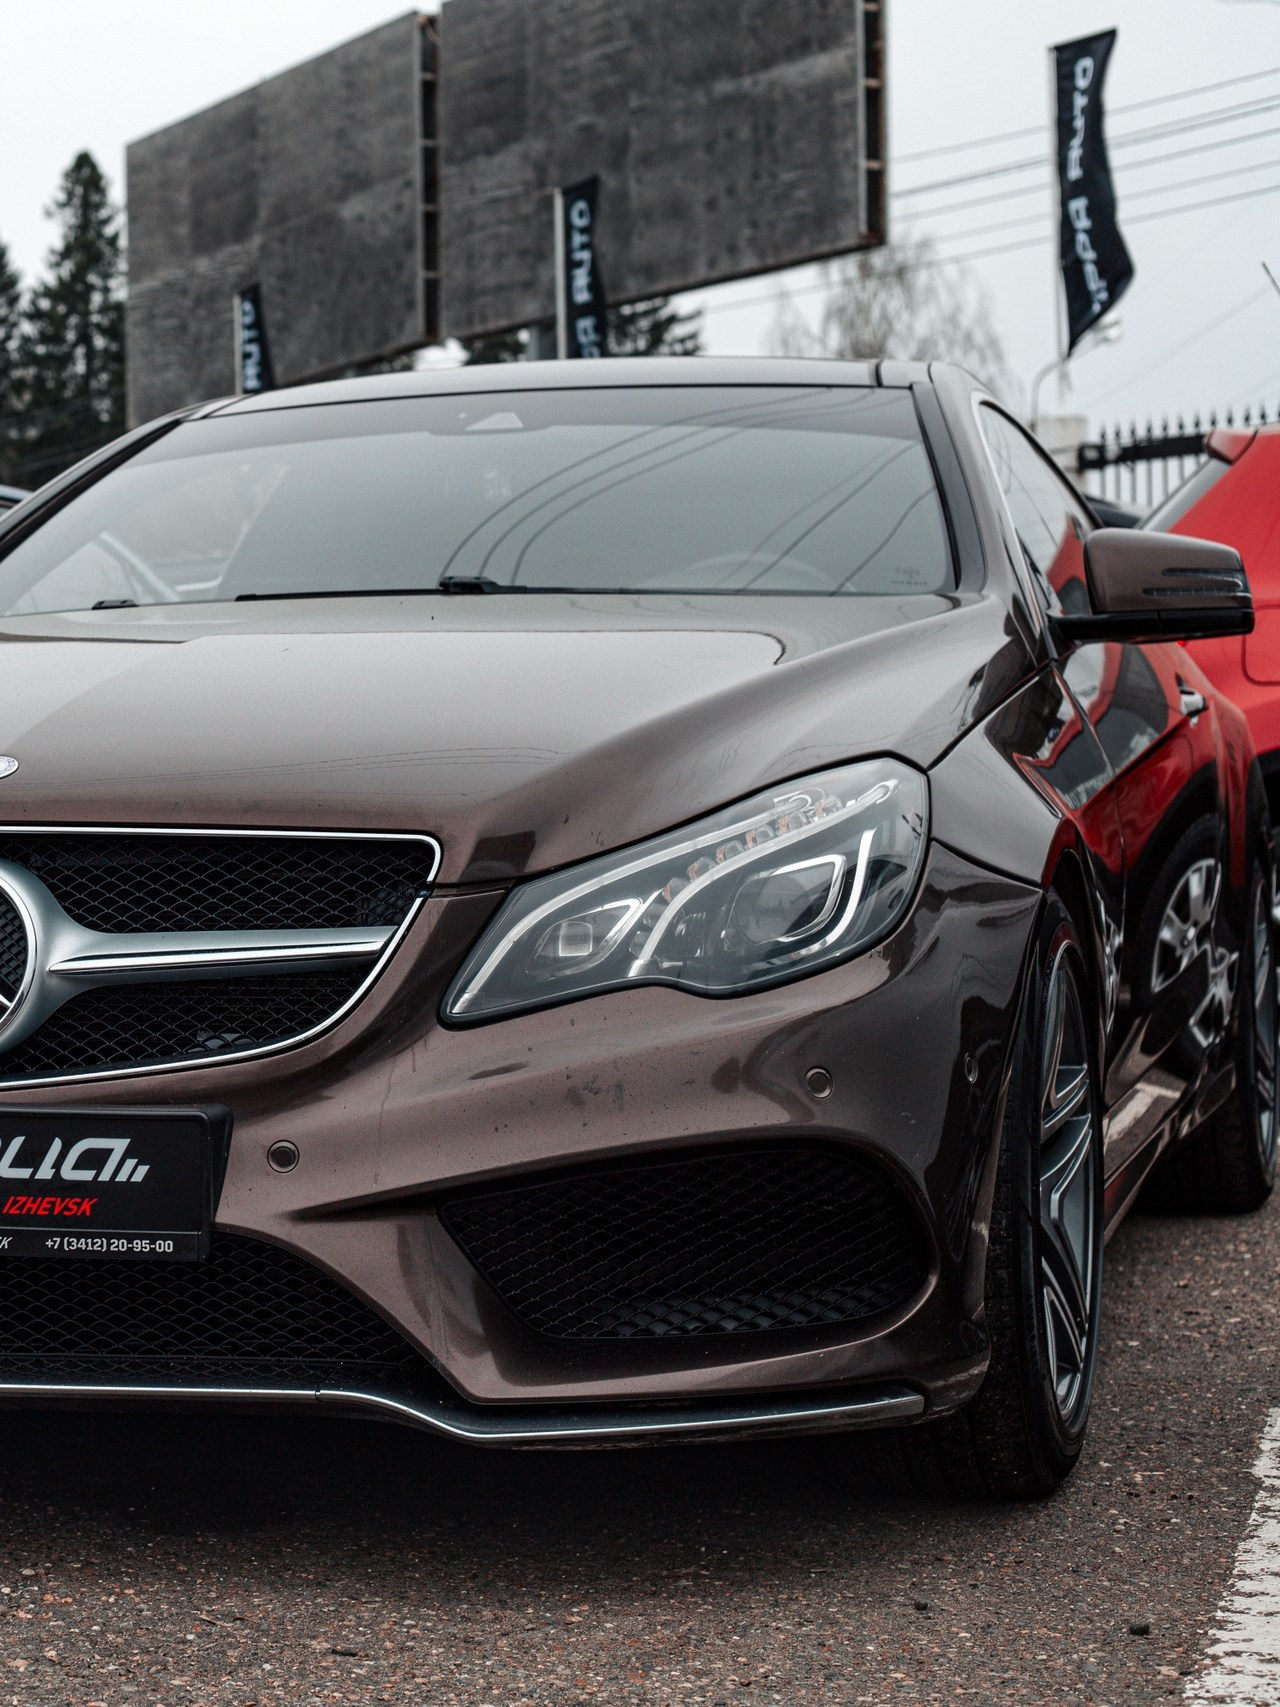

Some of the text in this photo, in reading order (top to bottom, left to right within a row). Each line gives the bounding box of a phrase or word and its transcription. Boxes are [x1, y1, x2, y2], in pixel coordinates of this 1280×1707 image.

[570, 199, 593, 305] AUTO
[2, 1195, 99, 1217] IZHEVSK
[45, 1237, 174, 1252] +7 (3412) 20-95-00
